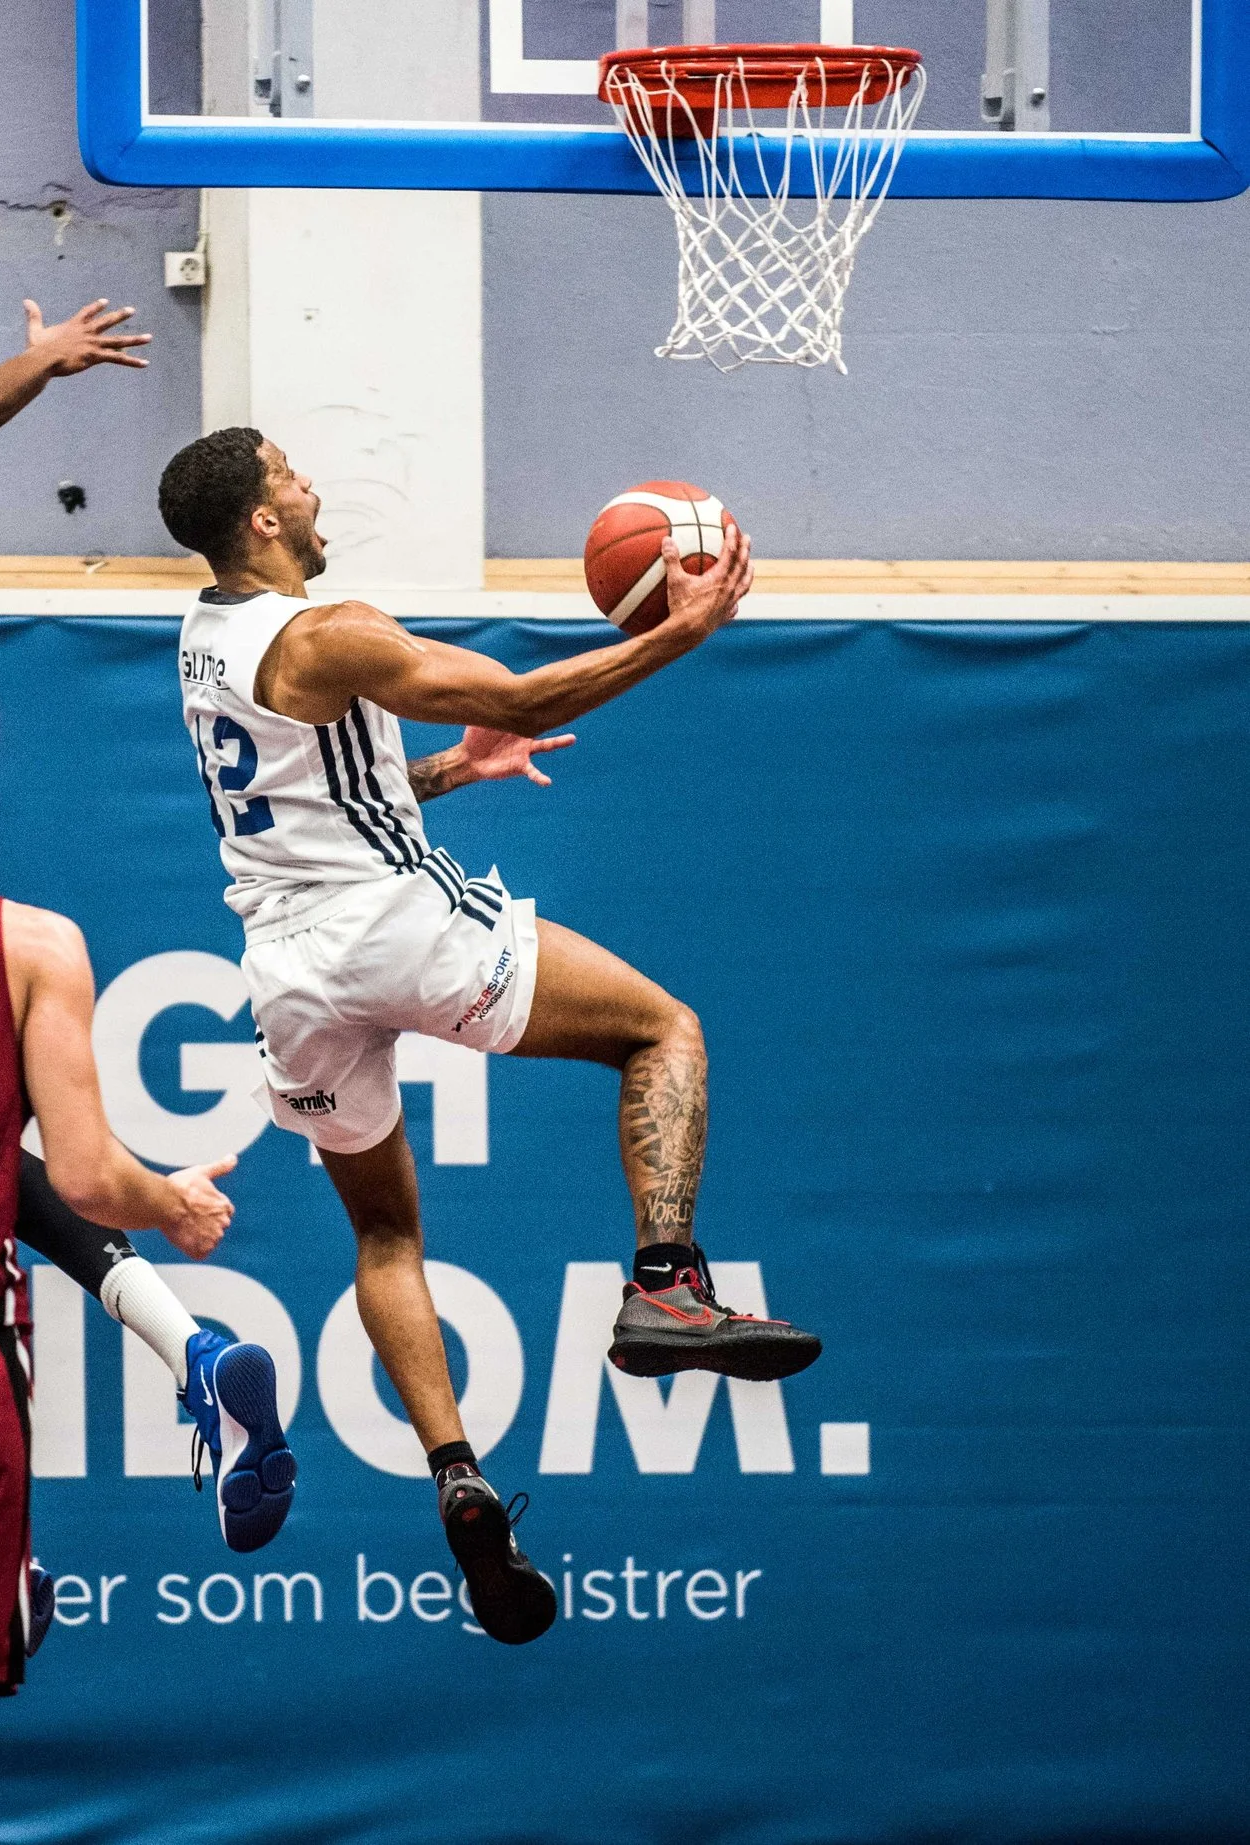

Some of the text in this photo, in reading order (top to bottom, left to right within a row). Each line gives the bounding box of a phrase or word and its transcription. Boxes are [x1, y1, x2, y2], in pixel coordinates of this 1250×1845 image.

[461, 946, 512, 1025] INTERSPORT
[477, 970, 514, 1021] KONGSBERG
[156, 1571, 324, 1624] som
[357, 1552, 762, 1636] beistrer
